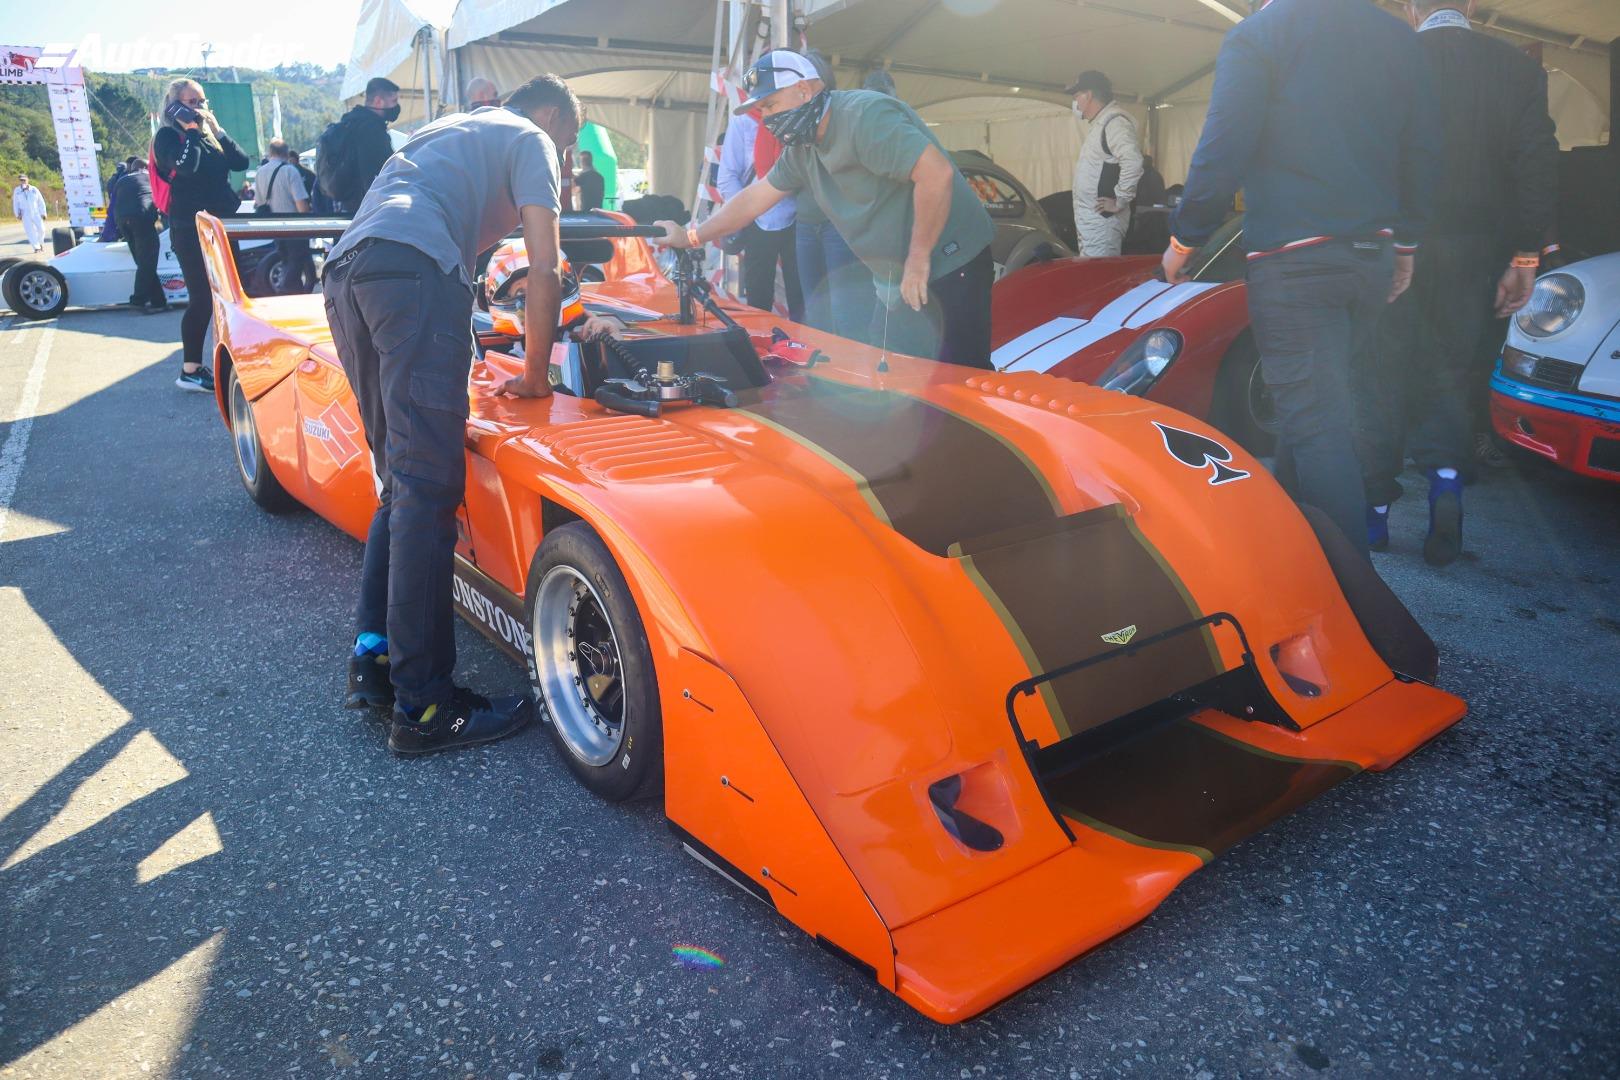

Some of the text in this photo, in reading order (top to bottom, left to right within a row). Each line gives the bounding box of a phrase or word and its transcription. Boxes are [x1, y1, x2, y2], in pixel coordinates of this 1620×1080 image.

[0, 68, 24, 78] LIMB
[304, 421, 330, 440] SUZUKI
[452, 573, 528, 656] UNSTON
